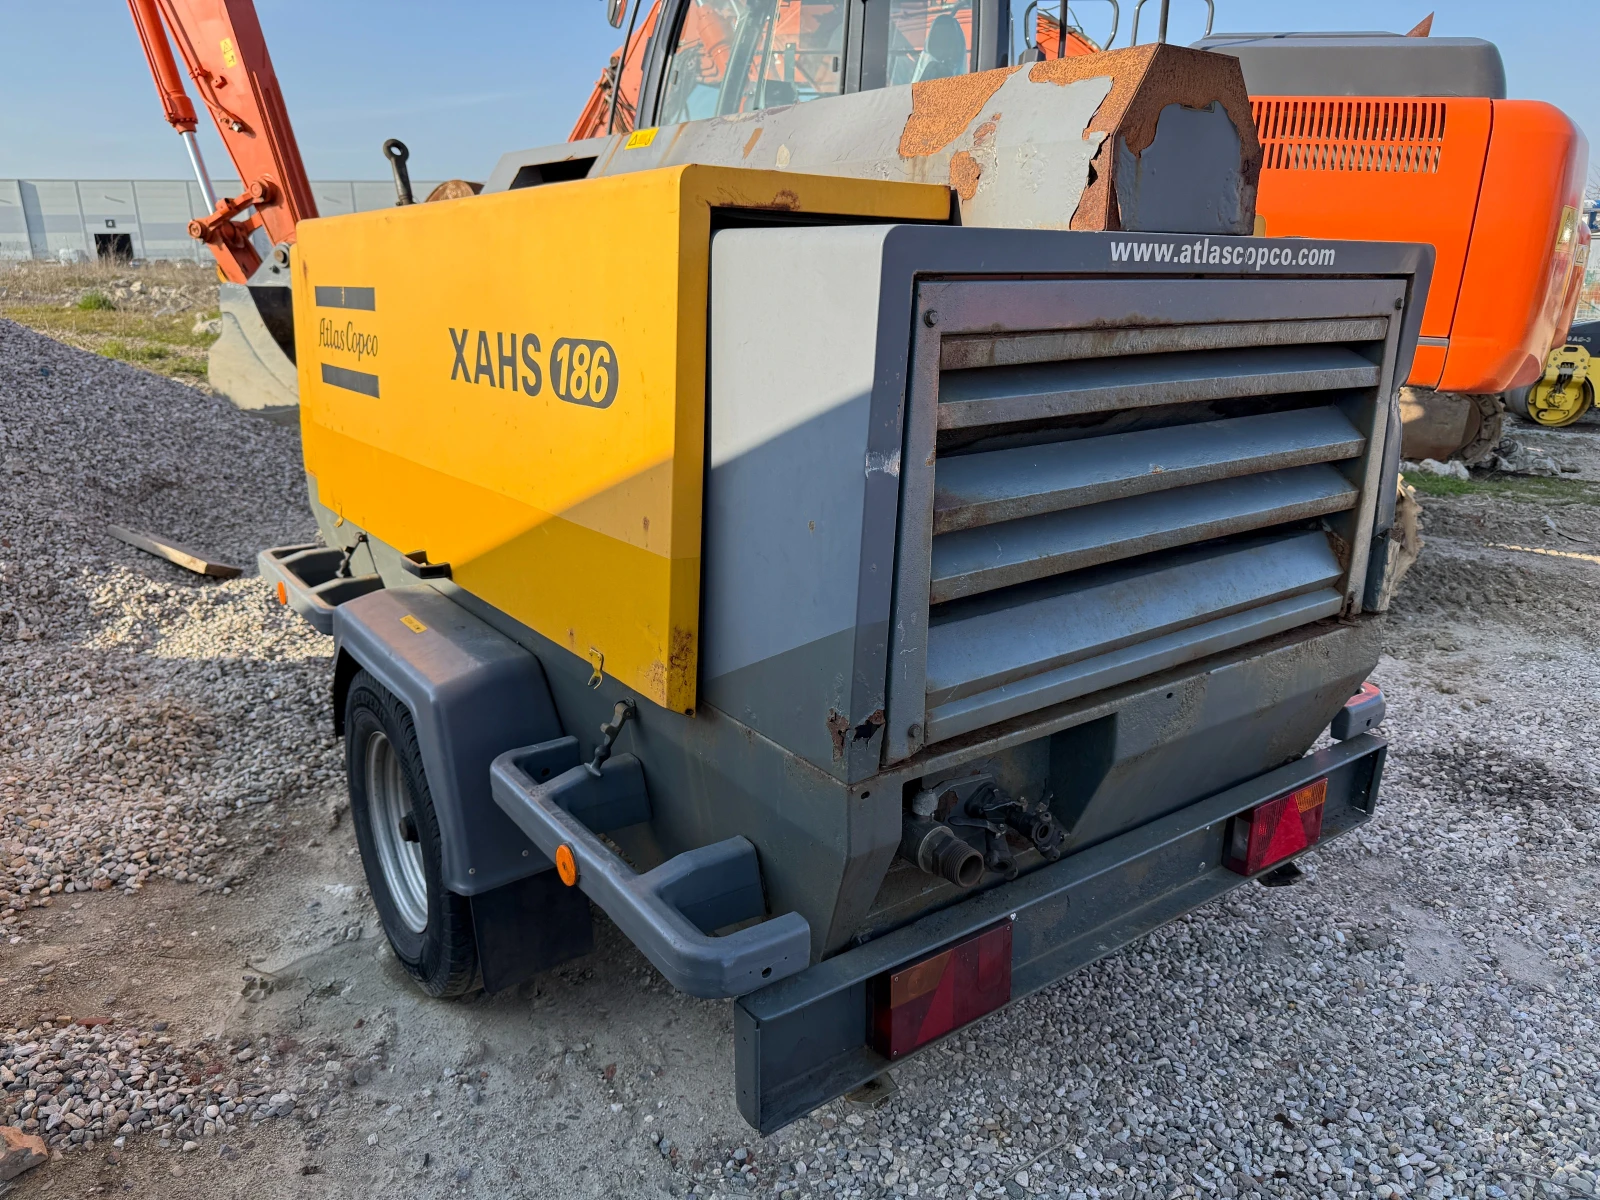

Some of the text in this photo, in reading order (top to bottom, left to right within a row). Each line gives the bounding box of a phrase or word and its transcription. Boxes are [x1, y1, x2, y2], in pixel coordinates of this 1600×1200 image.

[1110, 237, 1336, 271] www.atlascopco.com
[318, 317, 379, 362] Atlas Copco
[448, 326, 611, 403] XAHS 186
